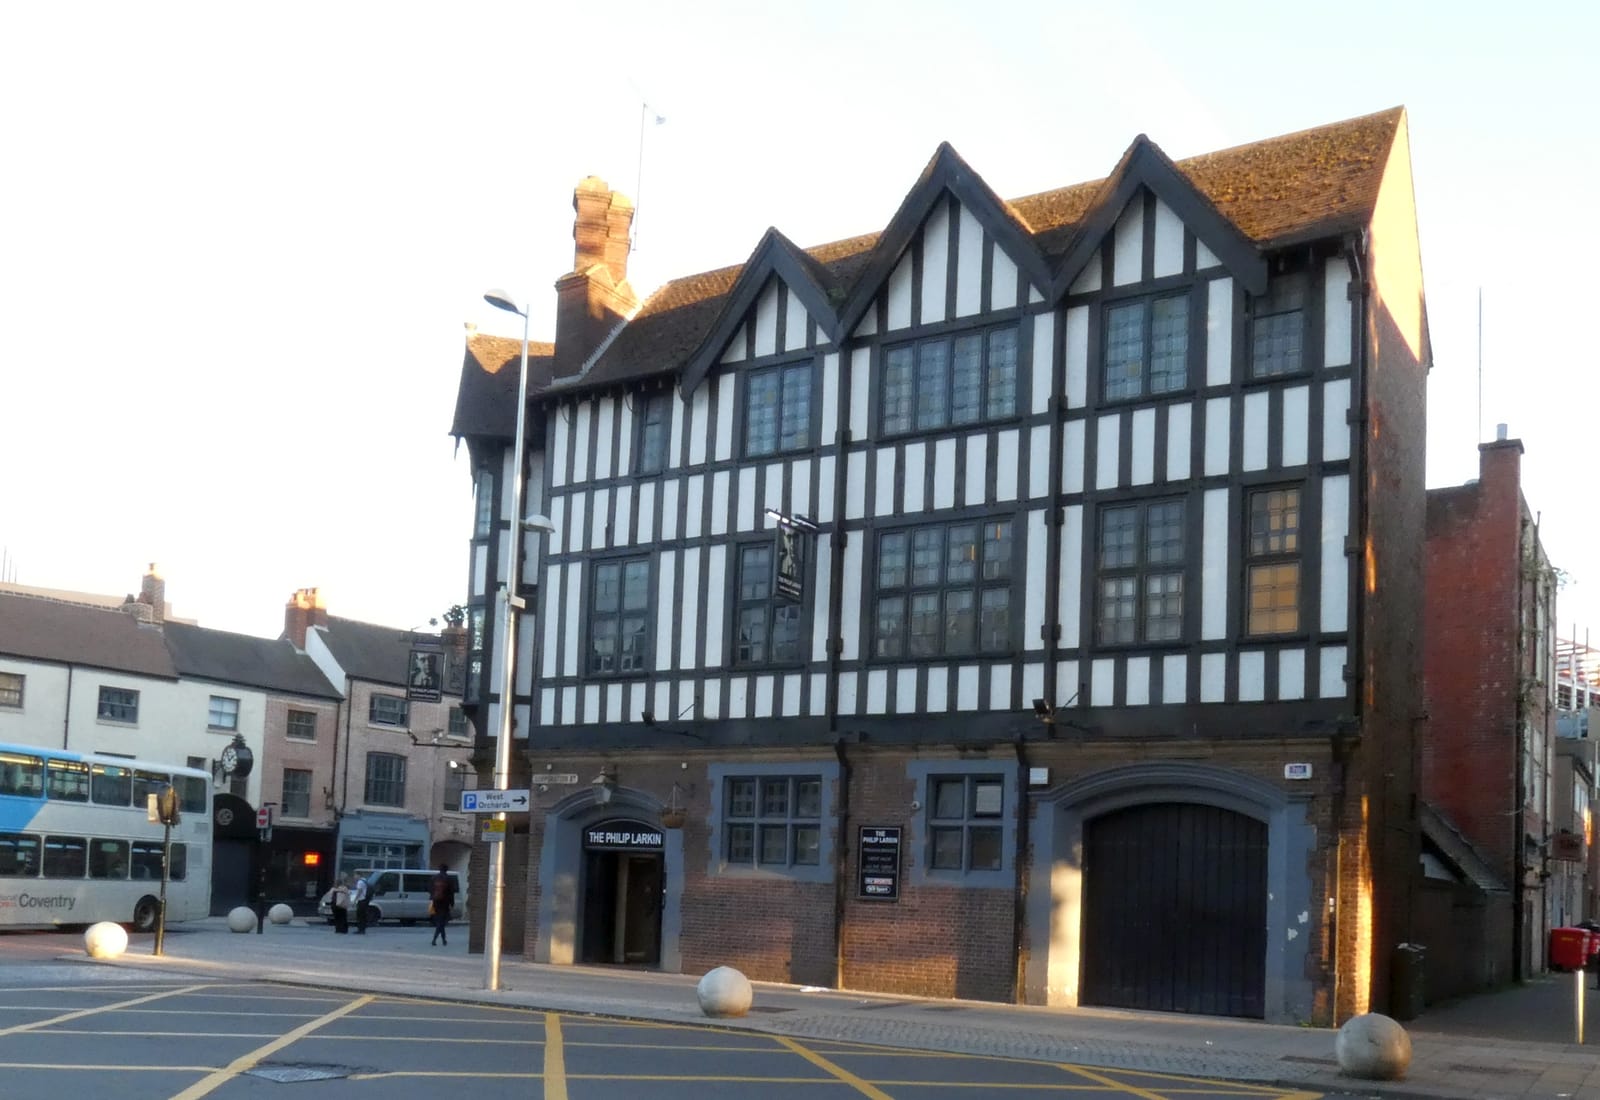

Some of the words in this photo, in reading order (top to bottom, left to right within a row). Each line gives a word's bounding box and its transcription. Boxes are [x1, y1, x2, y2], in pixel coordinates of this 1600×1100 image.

[478, 801, 510, 809] Orchards
[589, 832, 604, 843] THE
[605, 832, 630, 844] PHILIP
[631, 833, 662, 844] LARKIN
[19, 893, 76, 910] Coventry
